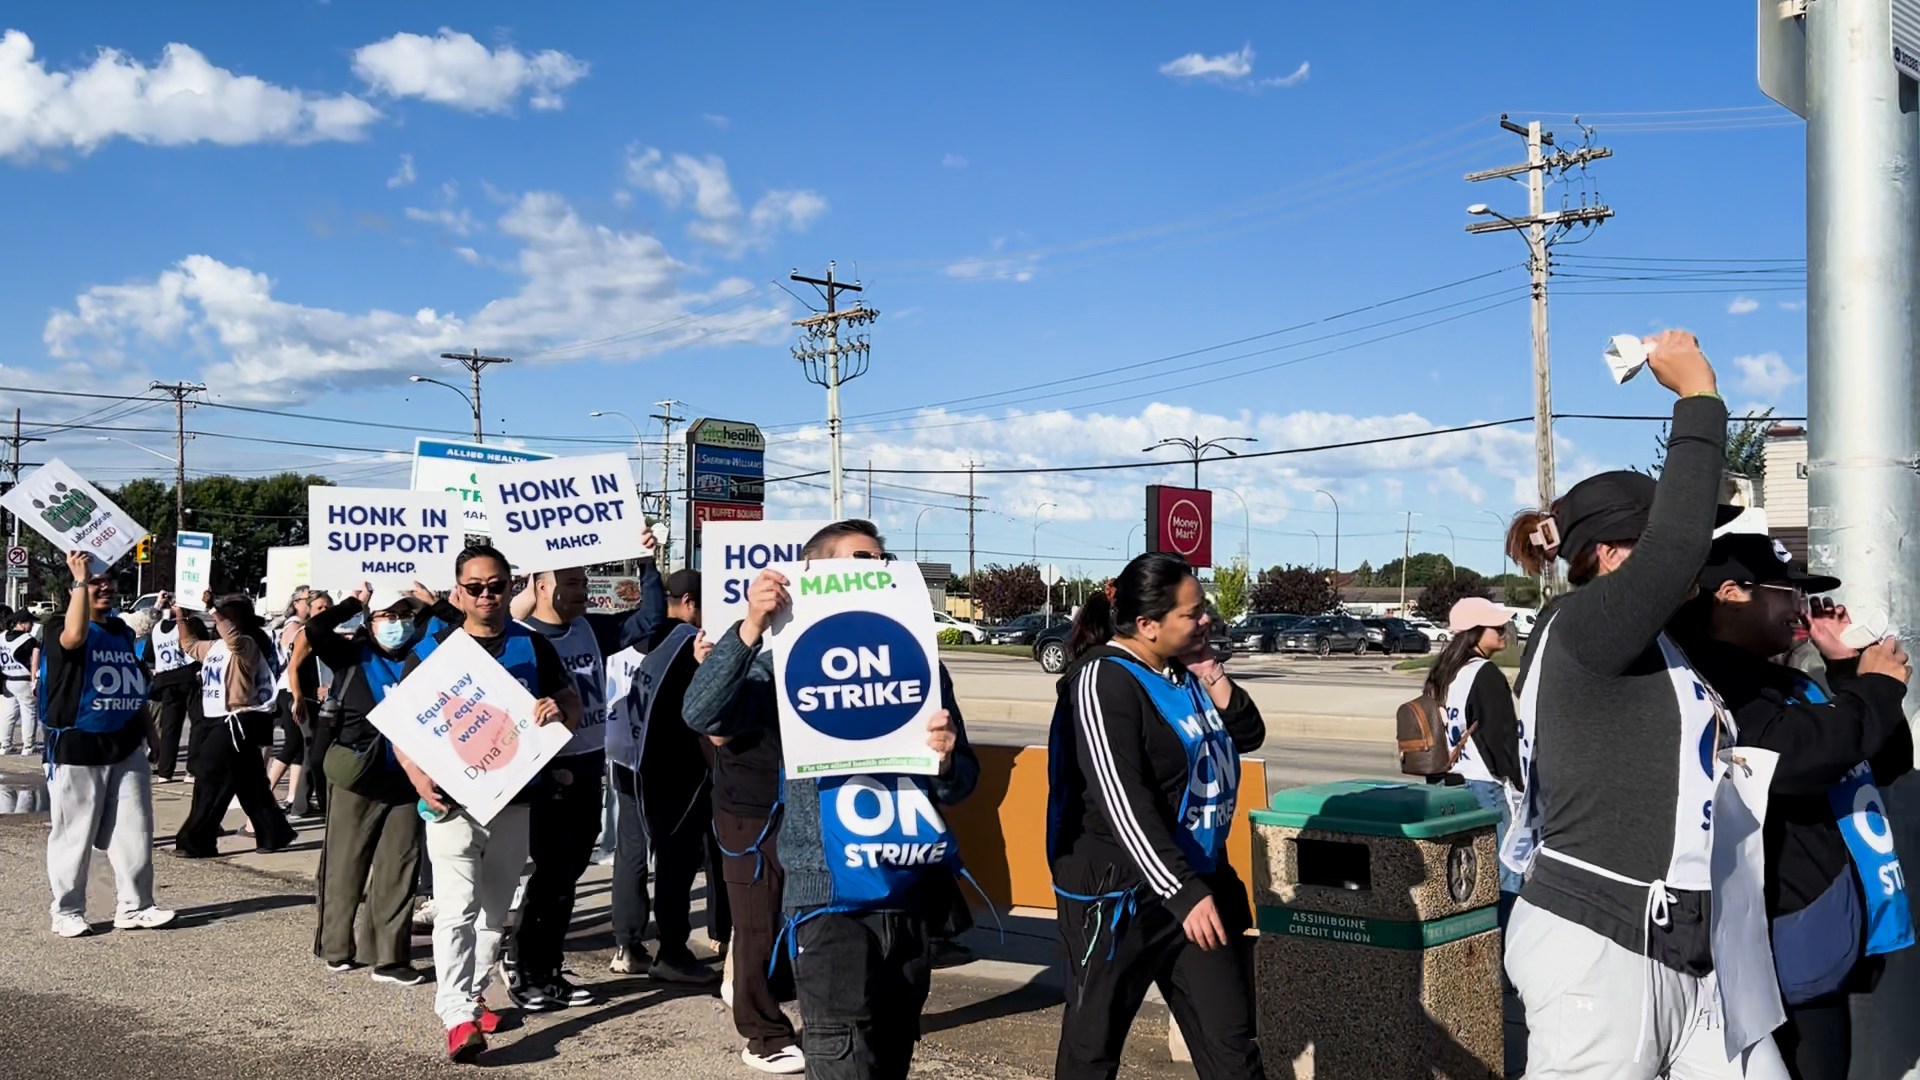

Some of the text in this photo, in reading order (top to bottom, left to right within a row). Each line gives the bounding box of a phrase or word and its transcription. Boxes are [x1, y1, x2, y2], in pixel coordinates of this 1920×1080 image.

[446, 448, 484, 459] ALLIED
[499, 477, 580, 505] HONK
[591, 473, 619, 495] IN
[328, 505, 447, 528] HONK IN
[506, 500, 625, 534] SUPPORT
[711, 507, 762, 520] BUFFET SQUARE
[1172, 516, 1199, 531] Money
[70, 511, 112, 544] Labcorporate
[91, 526, 117, 548] GREED
[1175, 528, 1193, 540] Mart
[327, 532, 448, 554] SUPPORT
[546, 534, 602, 552] MAHCP.
[362, 561, 417, 574] MAHCP.
[725, 544, 802, 570] HON
[182, 571, 200, 583] STRIKE
[801, 571, 897, 596] MAHCP.
[821, 644, 892, 680] ON
[92, 665, 146, 696] ON
[450, 672, 473, 697] pay
[91, 697, 142, 711] STRIKE
[416, 691, 451, 725] Equal
[797, 679, 923, 712] STRIKE
[433, 686, 486, 737] for equal
[458, 710, 492, 743] work!
[464, 746, 502, 780] Dyna
[501, 719, 529, 746] care
[1190, 737, 1237, 798] ON
[836, 775, 947, 837] ON
[1185, 798, 1234, 831] STRIKE
[844, 840, 948, 869] STRIKE
[1289, 924, 1371, 943] CREDIT UNION
[1292, 912, 1367, 930] ASSINIBOINE
